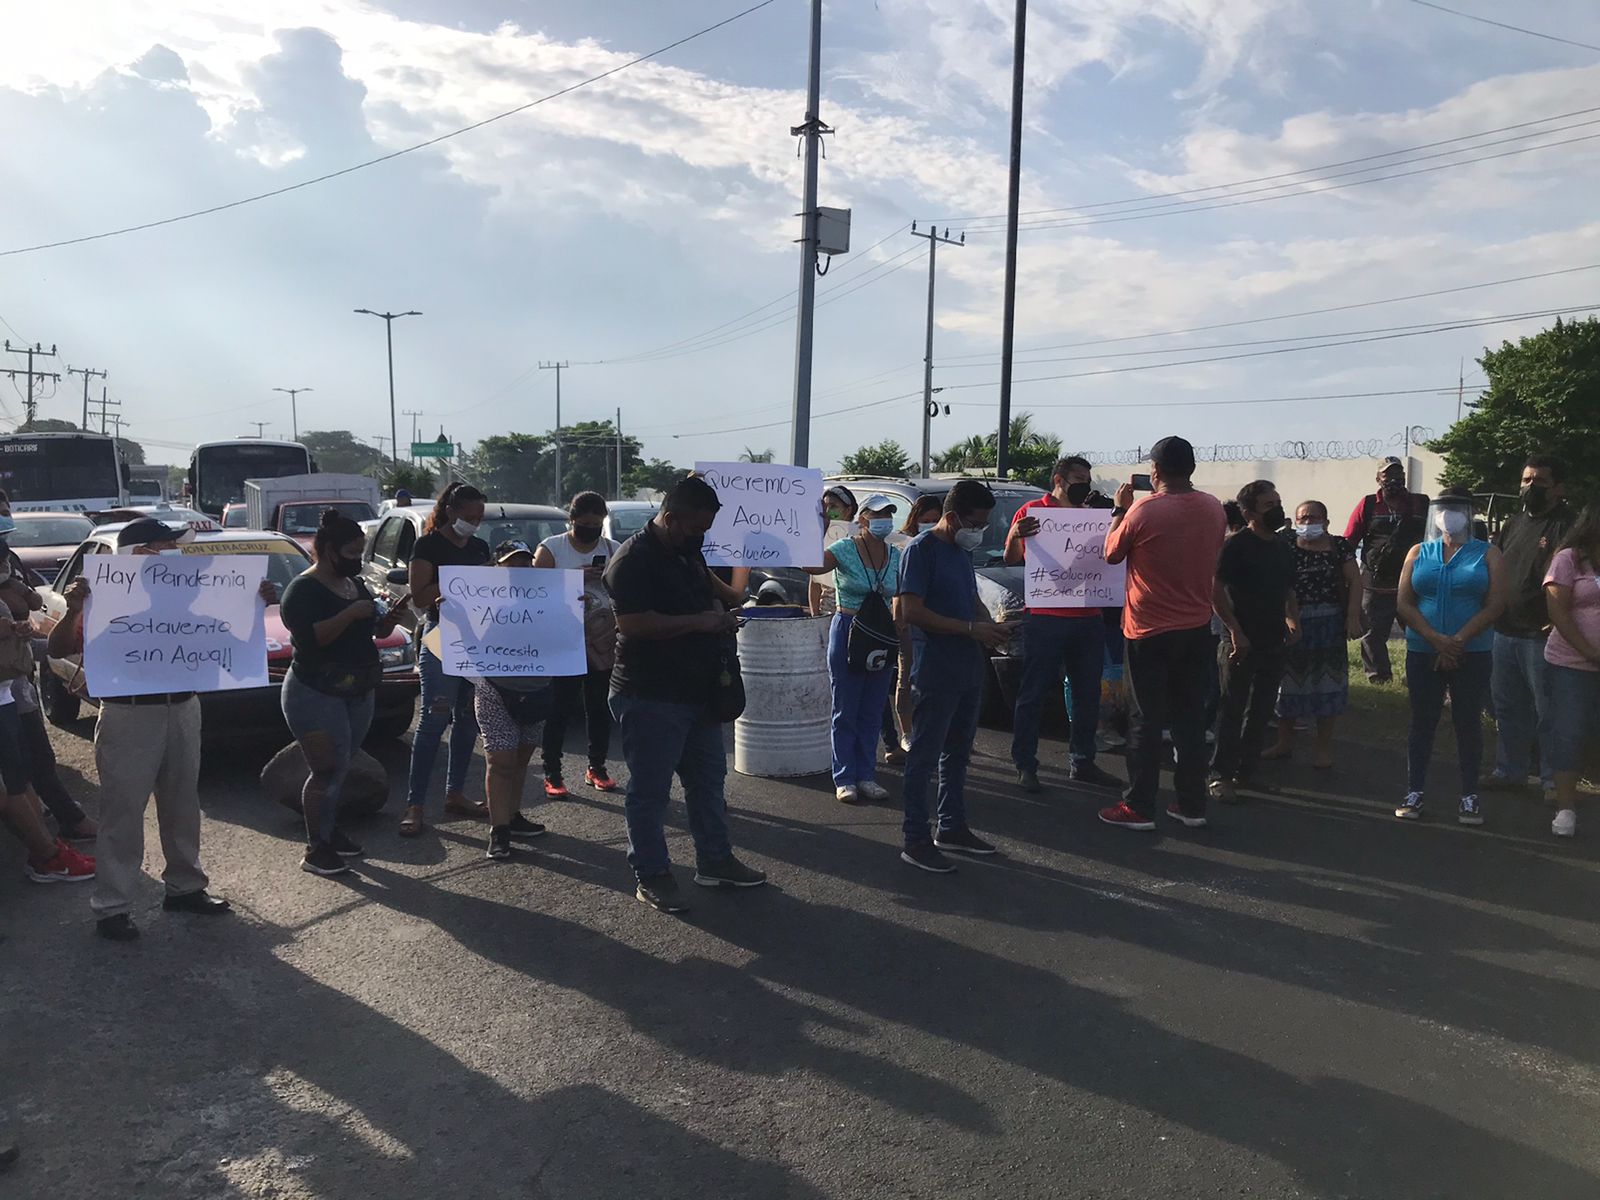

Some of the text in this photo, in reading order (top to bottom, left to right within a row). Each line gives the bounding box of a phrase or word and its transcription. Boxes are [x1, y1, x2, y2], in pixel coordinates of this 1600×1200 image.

[703, 469, 806, 496] Queremos
[188, 521, 212, 530] TAXI
[1041, 518, 1112, 533] Queremo
[181, 543, 270, 554] ION VERACRUZ
[95, 563, 246, 594] Hay Pandemia
[448, 576, 549, 600] Queremos
[109, 615, 232, 635] Sotavento
[125, 645, 232, 672] sin Agua!!
[450, 640, 539, 658] Se necesita
